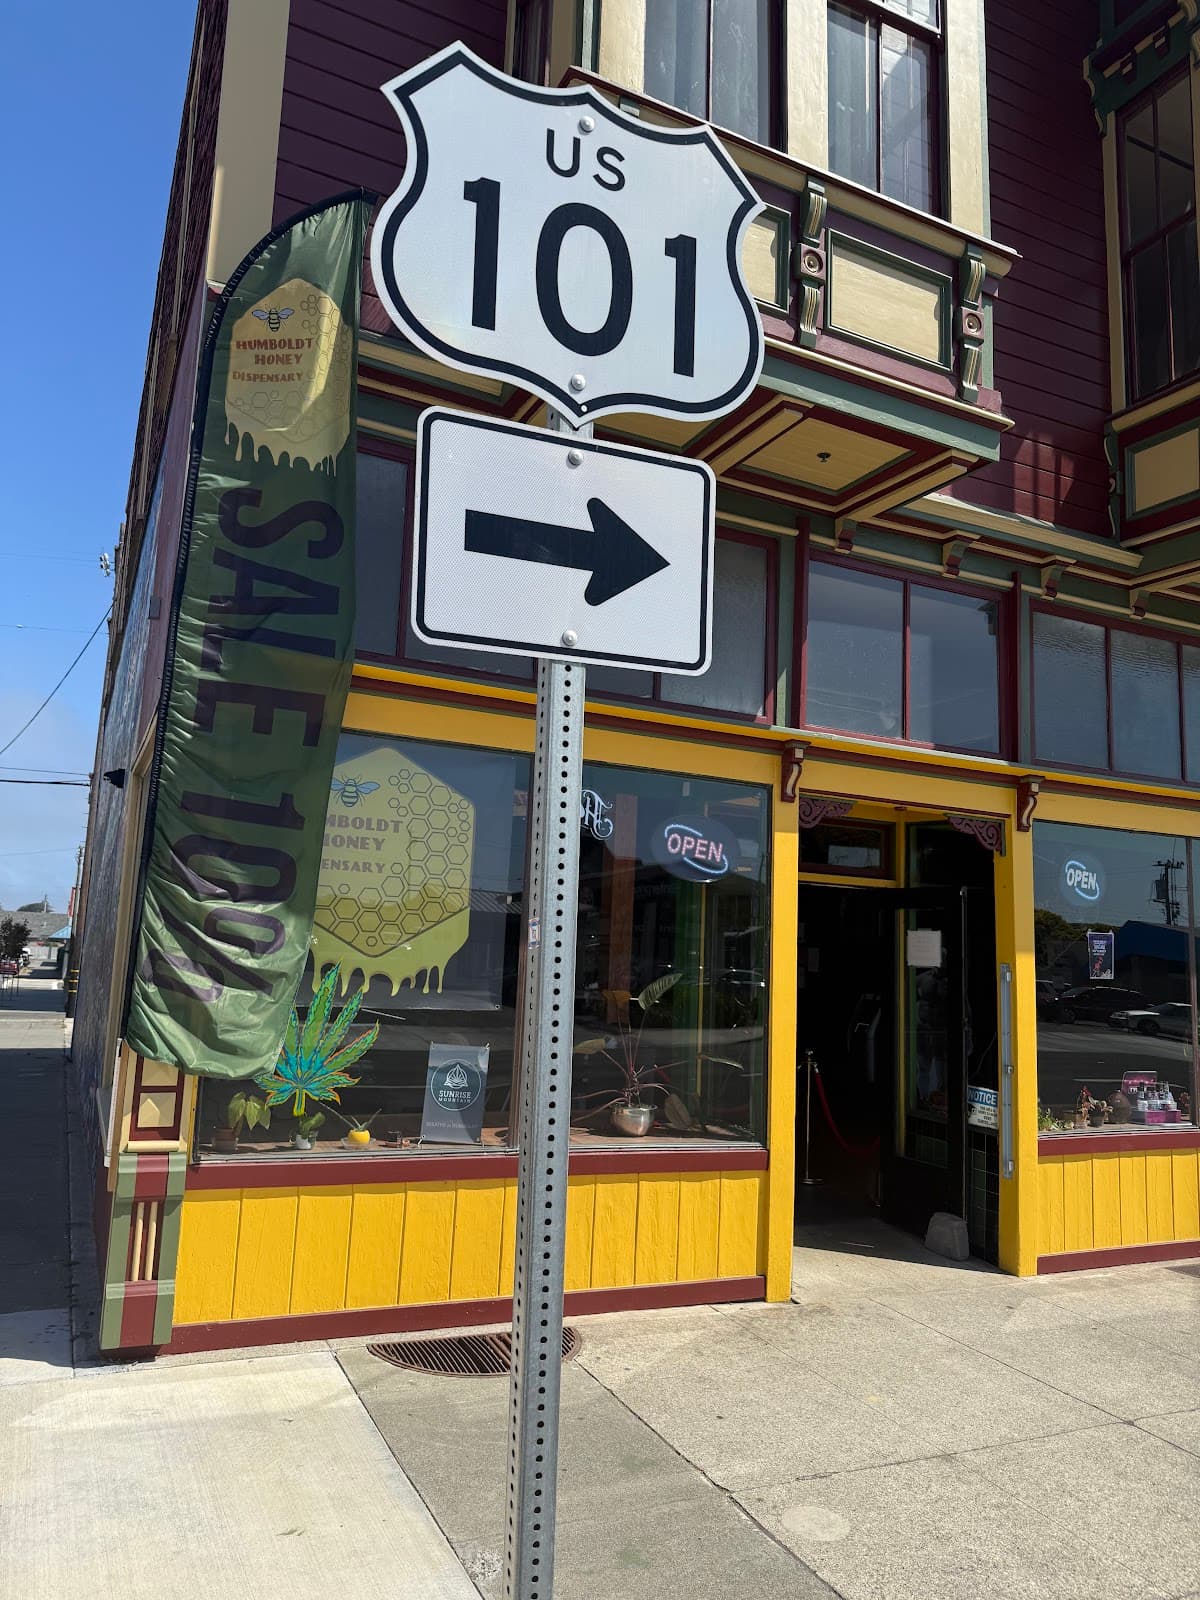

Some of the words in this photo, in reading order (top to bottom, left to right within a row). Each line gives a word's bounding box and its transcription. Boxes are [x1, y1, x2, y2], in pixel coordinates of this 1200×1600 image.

[545, 127, 626, 192] US
[463, 176, 698, 378] 101
[235, 338, 314, 350] HUMBOLDT
[254, 353, 303, 365] HONEY
[232, 371, 304, 383] DISPENSARY
[192, 487, 344, 747] SALE
[325, 814, 403, 833] MBOLDT
[667, 833, 723, 863] OPEN
[321, 859, 386, 874] ENSARY
[1066, 868, 1096, 890] OPEN
[142, 789, 305, 1003] 10%
[438, 1090, 472, 1099] SUNRISE
[968, 1089, 997, 1105] NOTICE
